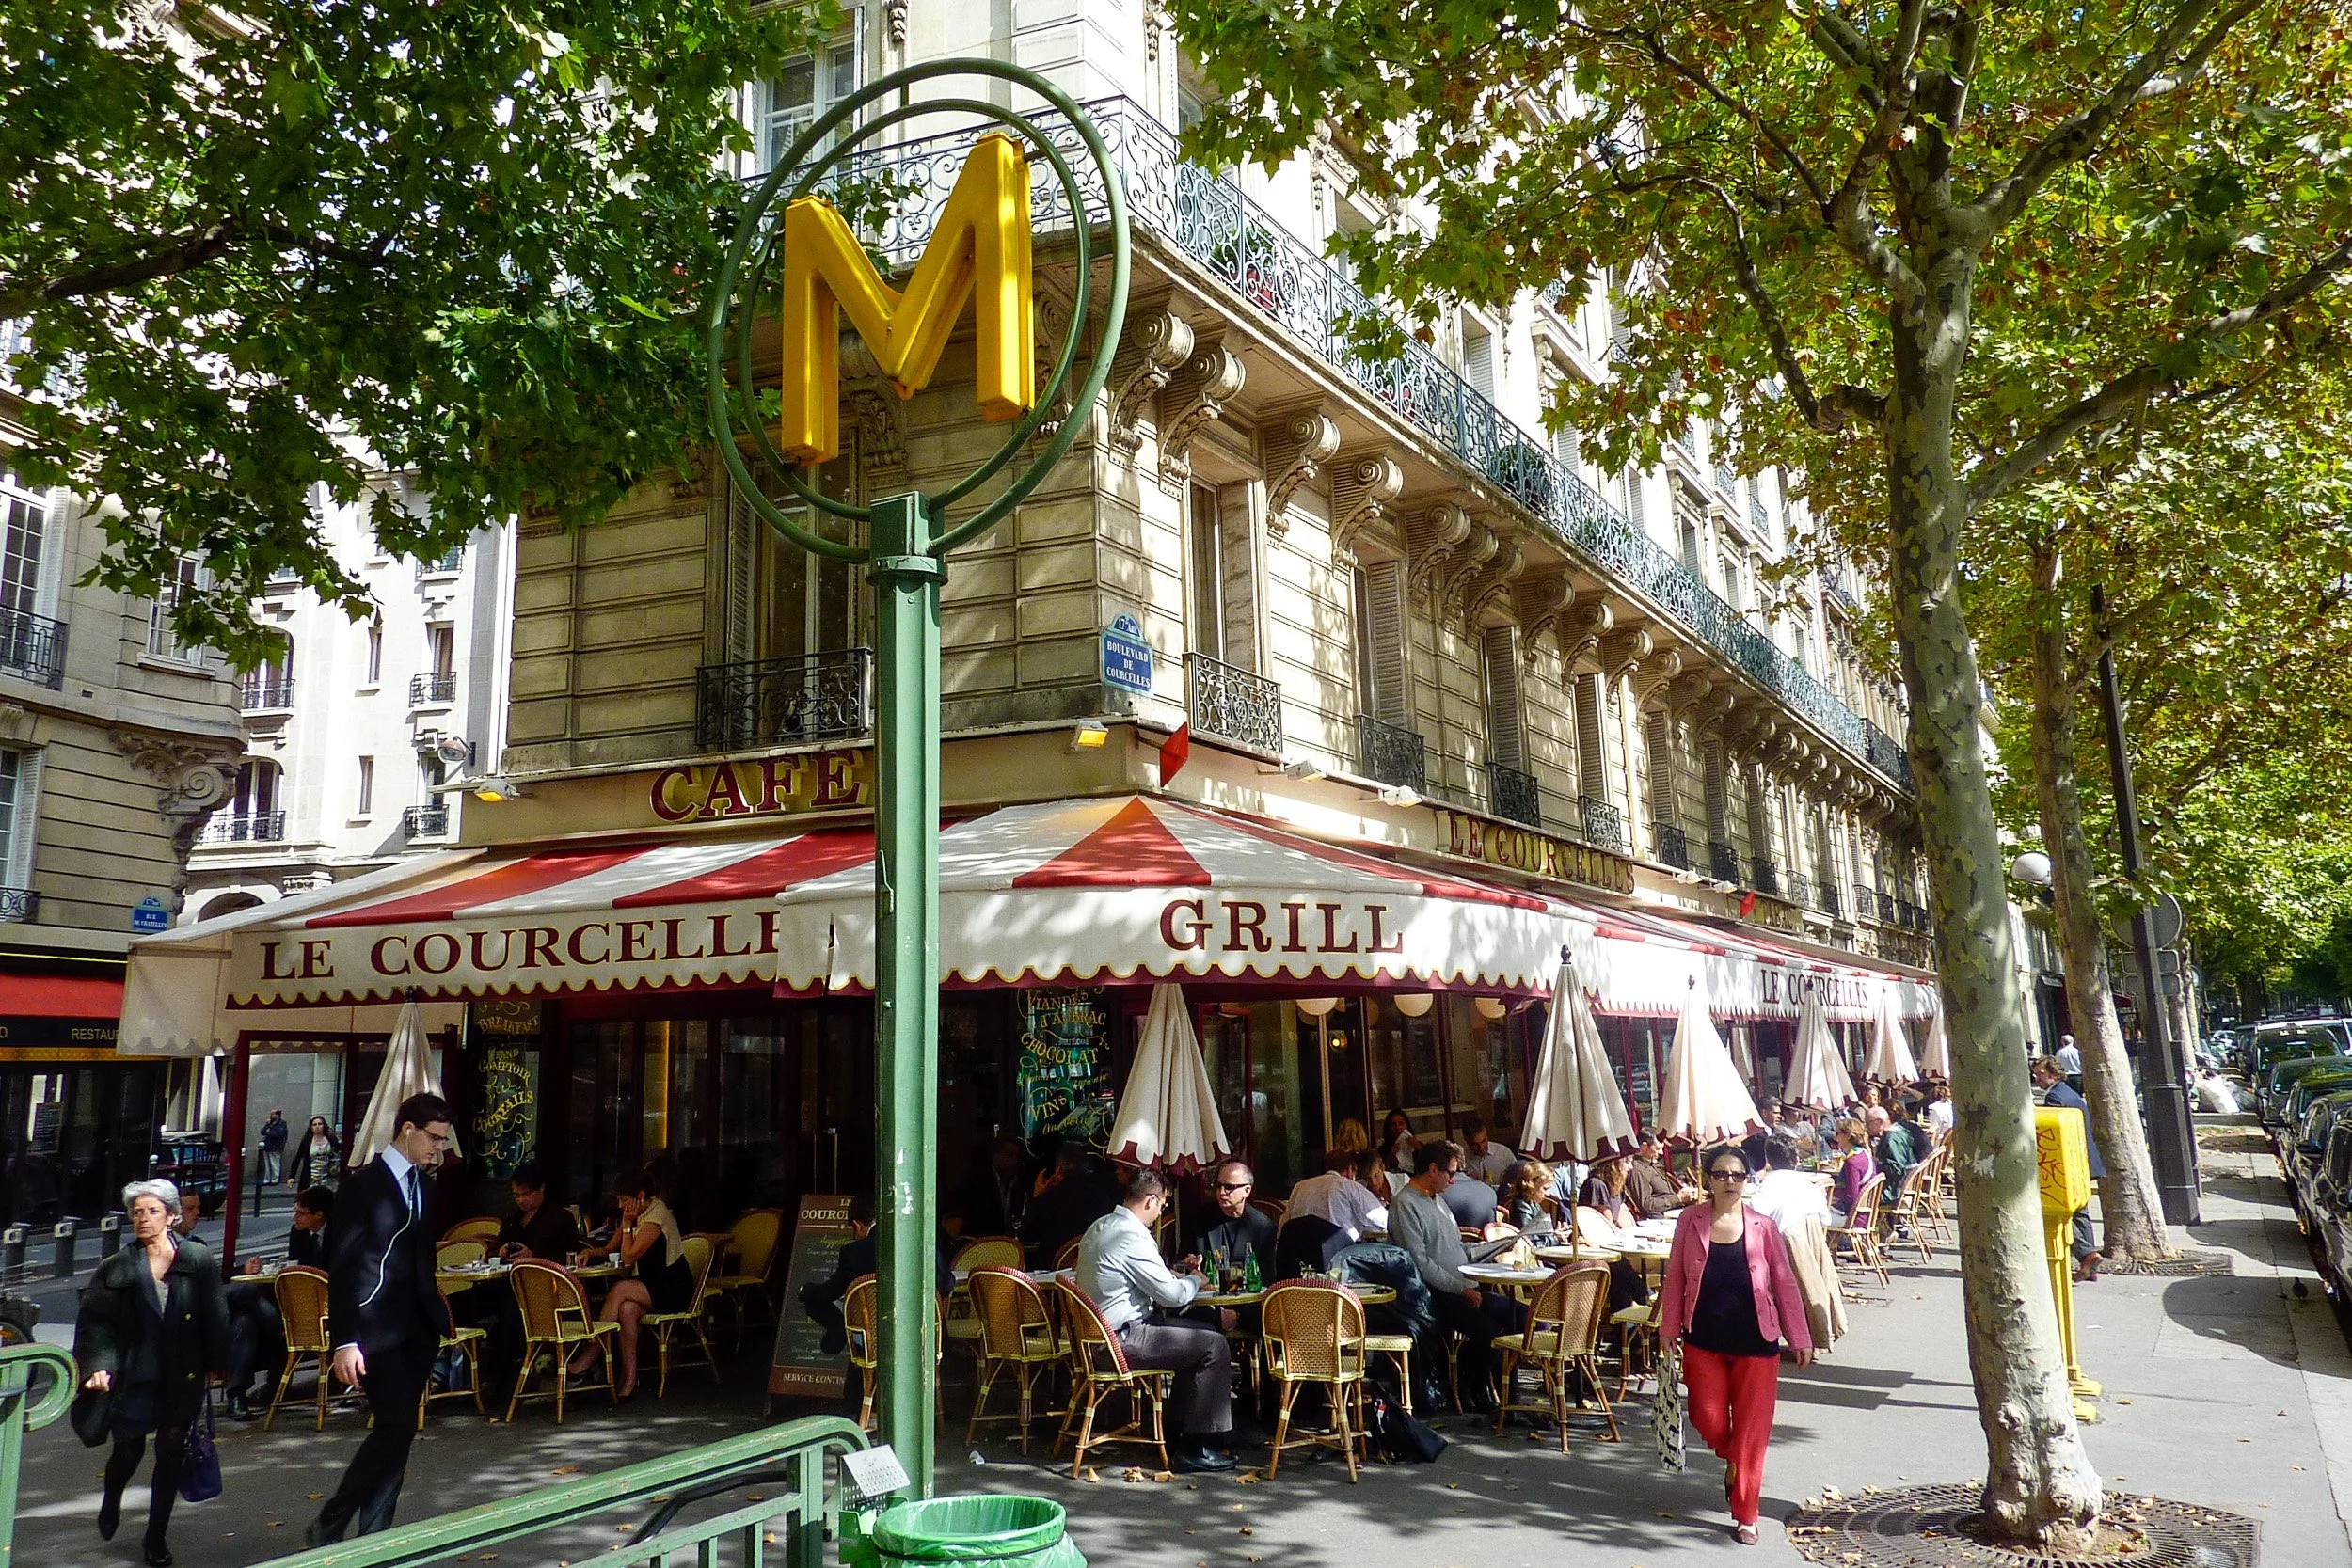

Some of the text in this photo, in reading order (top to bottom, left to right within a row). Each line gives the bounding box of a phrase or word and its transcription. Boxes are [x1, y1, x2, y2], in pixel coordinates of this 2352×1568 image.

[782, 132, 1035, 466] M
[1107, 641, 1148, 662] BOULEVARD
[1123, 658, 1134, 671] DE
[1106, 666, 1150, 687] COURCELLES
[1448, 809, 1635, 895] LE COURCELLES
[1160, 898, 1404, 954] GRILL
[261, 911, 780, 980] LE COURCELLE
[1025, 989, 1089, 1010] VIANDES
[1761, 969, 1779, 1004] LE
[477, 1016, 539, 1036] BREAKFAST
[1021, 1032, 1098, 1064] CHOCOLAT
[472, 1090, 534, 1132] COCKTAILS
[1029, 1095, 1068, 1122] VINS
[783, 1373, 814, 1383] SERVICE
